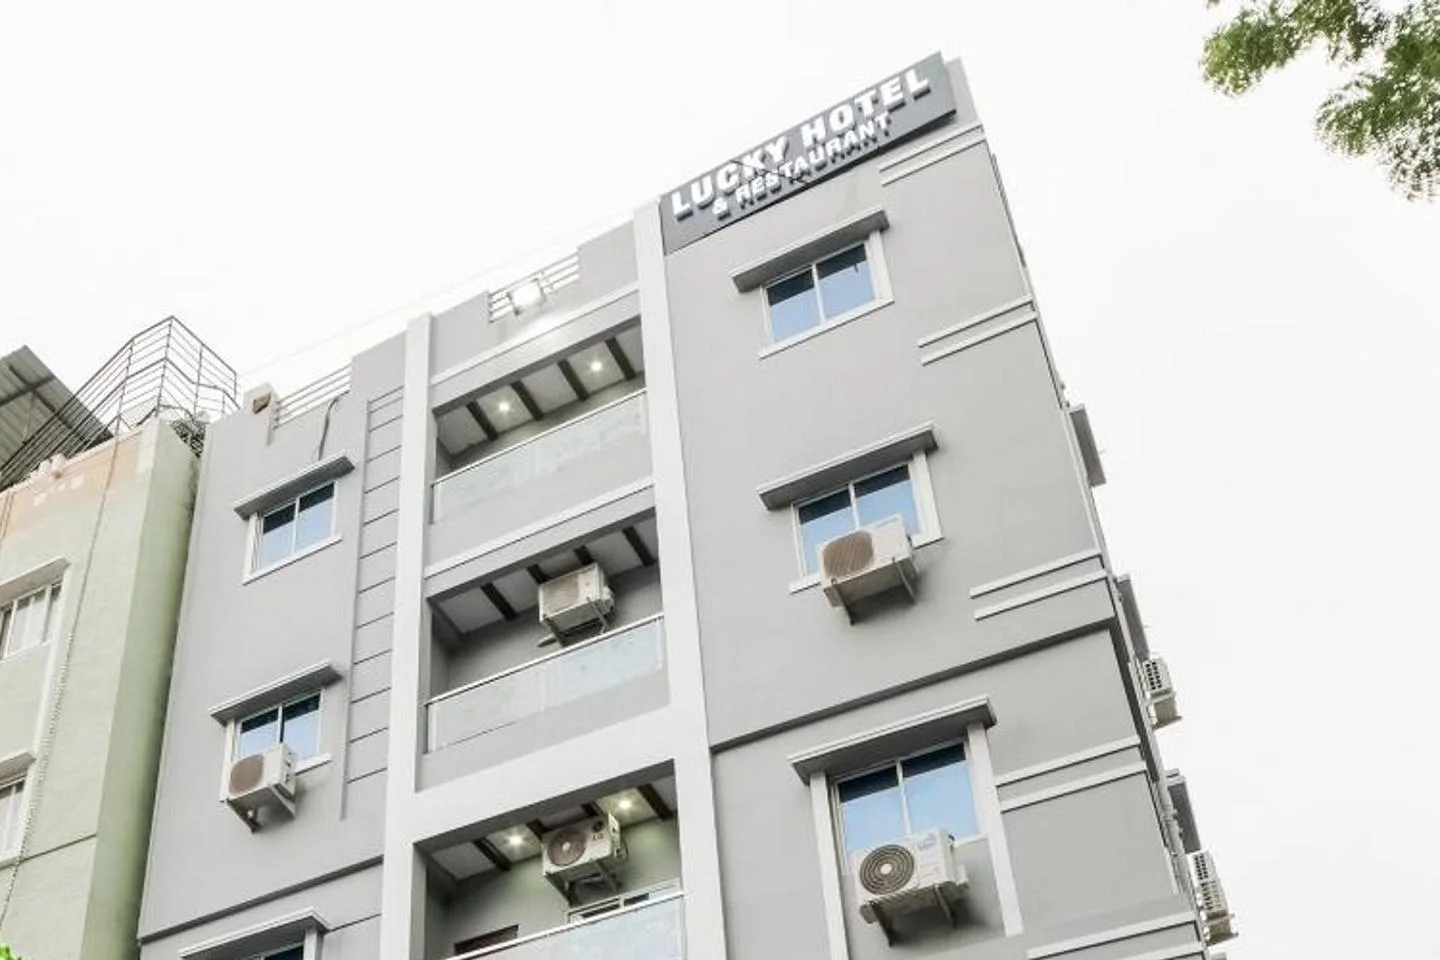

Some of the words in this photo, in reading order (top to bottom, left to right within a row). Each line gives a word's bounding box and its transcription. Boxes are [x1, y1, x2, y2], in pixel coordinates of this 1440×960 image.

[671, 137, 790, 219] LUCKY
[801, 68, 930, 148] HOTEL
[712, 197, 731, 218] &
[736, 111, 892, 206] RESTAURANT
